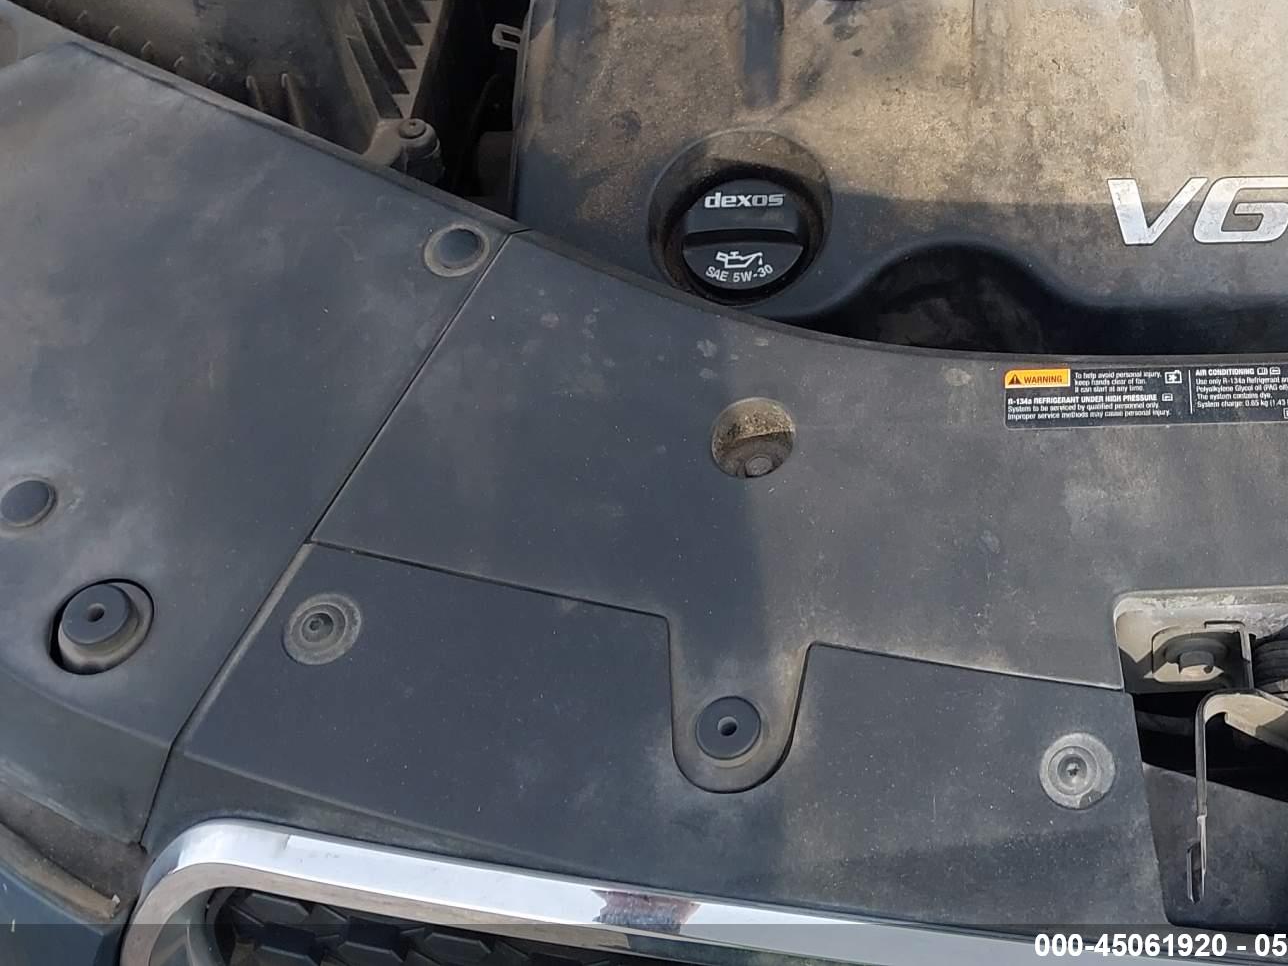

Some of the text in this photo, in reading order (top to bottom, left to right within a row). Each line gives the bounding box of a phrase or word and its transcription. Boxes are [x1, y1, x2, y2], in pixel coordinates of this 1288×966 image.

[704, 191, 786, 208] dexos
[705, 264, 774, 283] SAE 5W-30
[1024, 375, 1062, 384] WARNING
[1034, 396, 1079, 404] REFRIGERANT
[1123, 394, 1157, 402] PRESSURE
